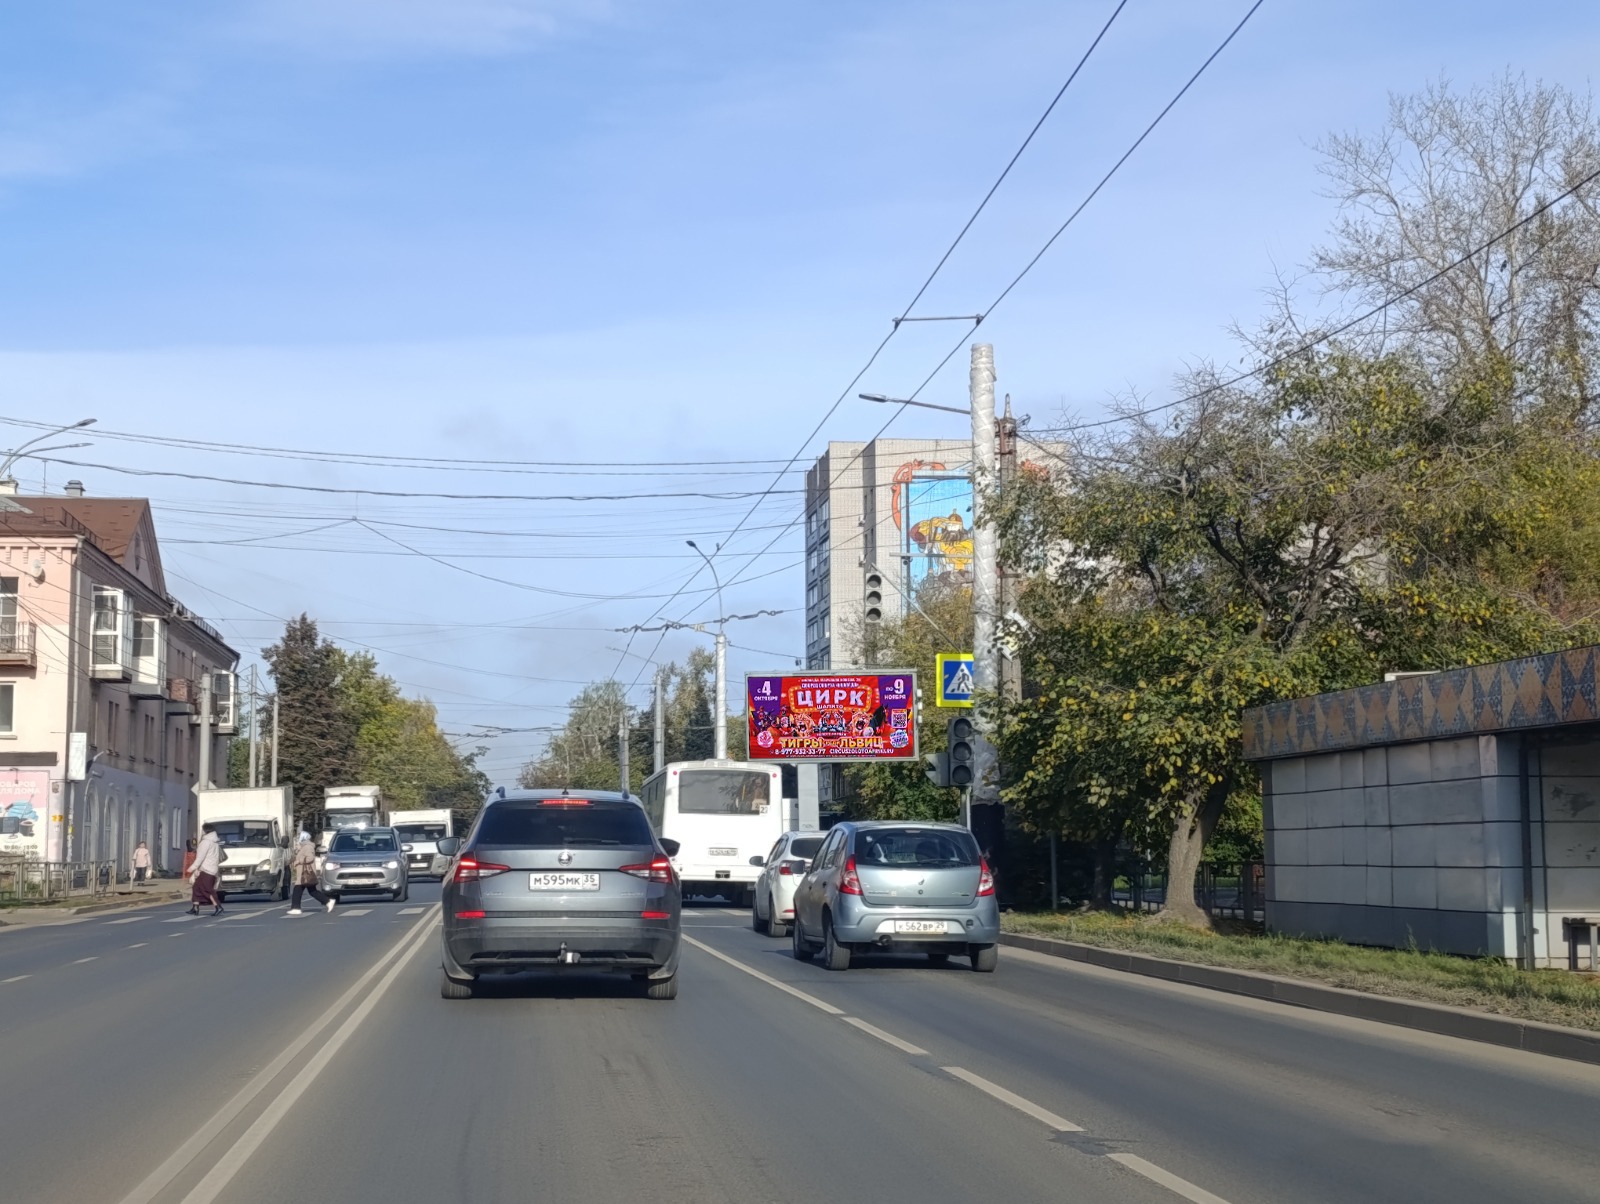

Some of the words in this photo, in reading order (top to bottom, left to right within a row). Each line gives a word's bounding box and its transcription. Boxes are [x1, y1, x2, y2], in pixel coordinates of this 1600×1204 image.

[762, 681, 772, 696] 4
[894, 678, 904, 694] 9
[797, 689, 865, 706] ЦИРК
[780, 737, 823, 748] ТИГРЫ
[840, 737, 883, 749] ЛЬВИЦ
[534, 875, 581, 885] М595МК
